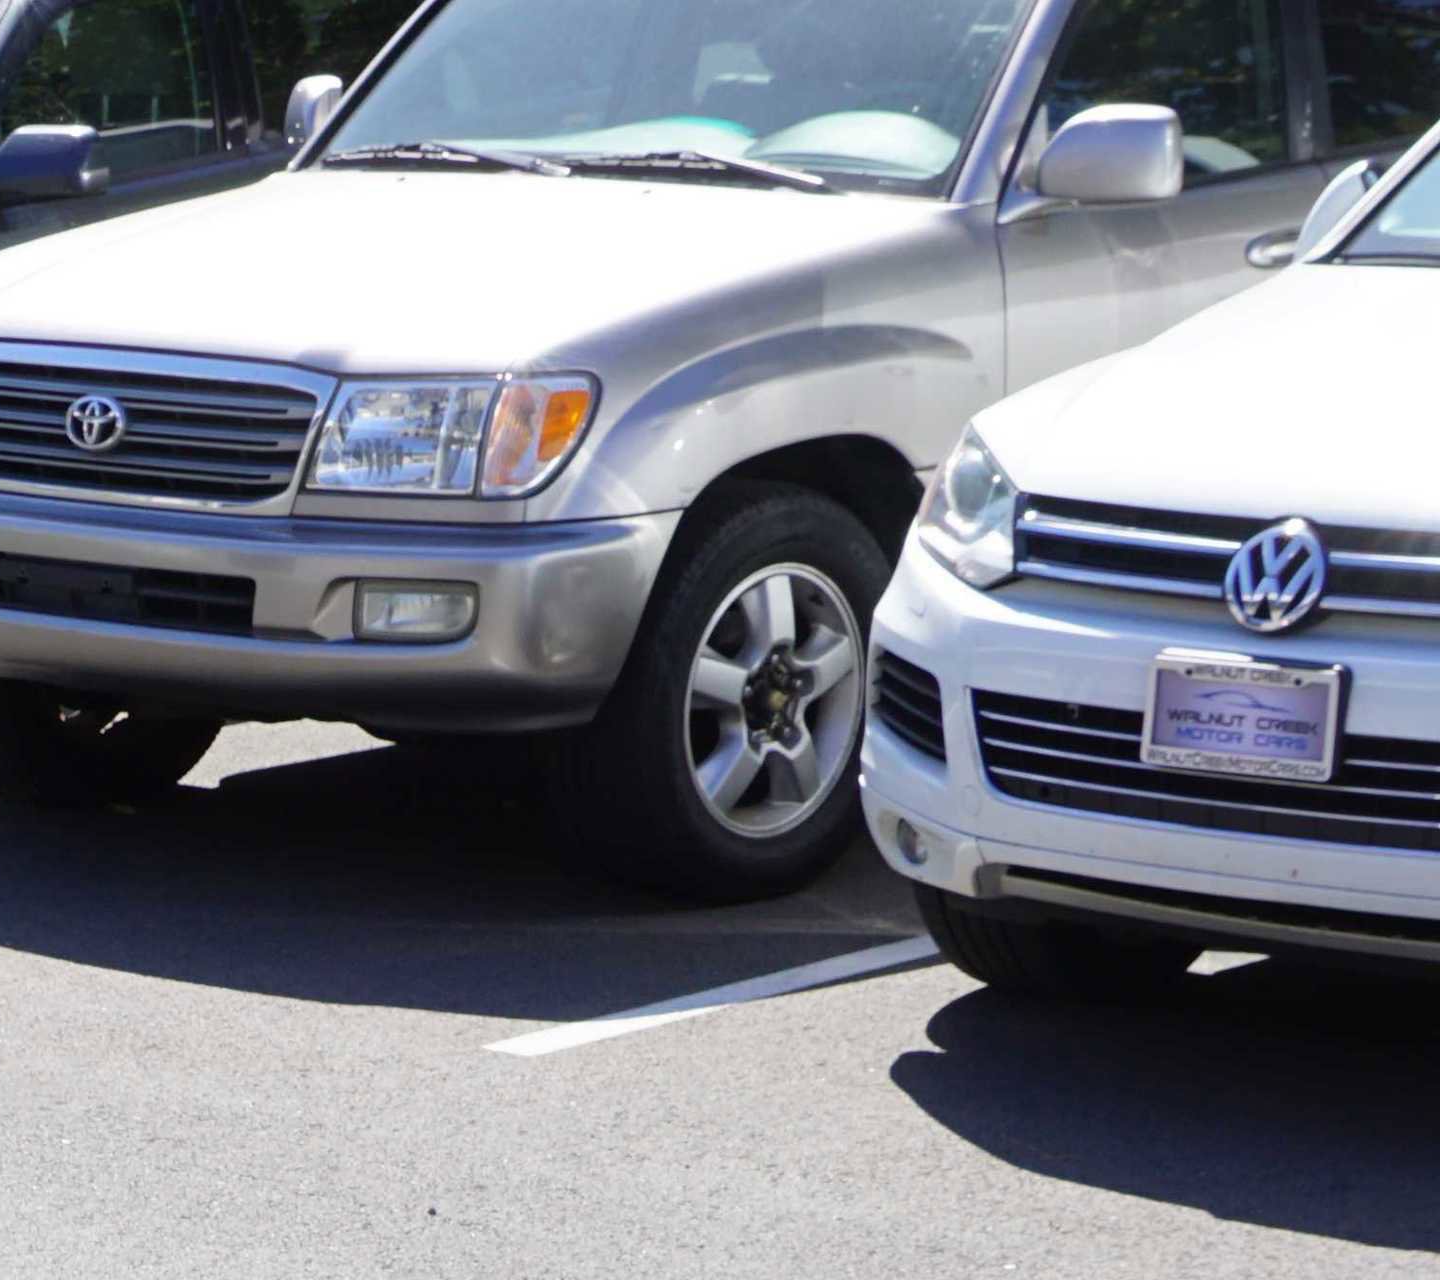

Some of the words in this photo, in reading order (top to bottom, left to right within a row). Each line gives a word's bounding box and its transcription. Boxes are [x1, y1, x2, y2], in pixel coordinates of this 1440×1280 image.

[1195, 663, 1245, 679] WALNUT
[1249, 668, 1292, 683] CREEK
[1167, 708, 1244, 727] WALNUT
[1255, 716, 1320, 736] CREEK
[1176, 726, 1244, 744] MOTOR
[1253, 733, 1307, 751] CARS
